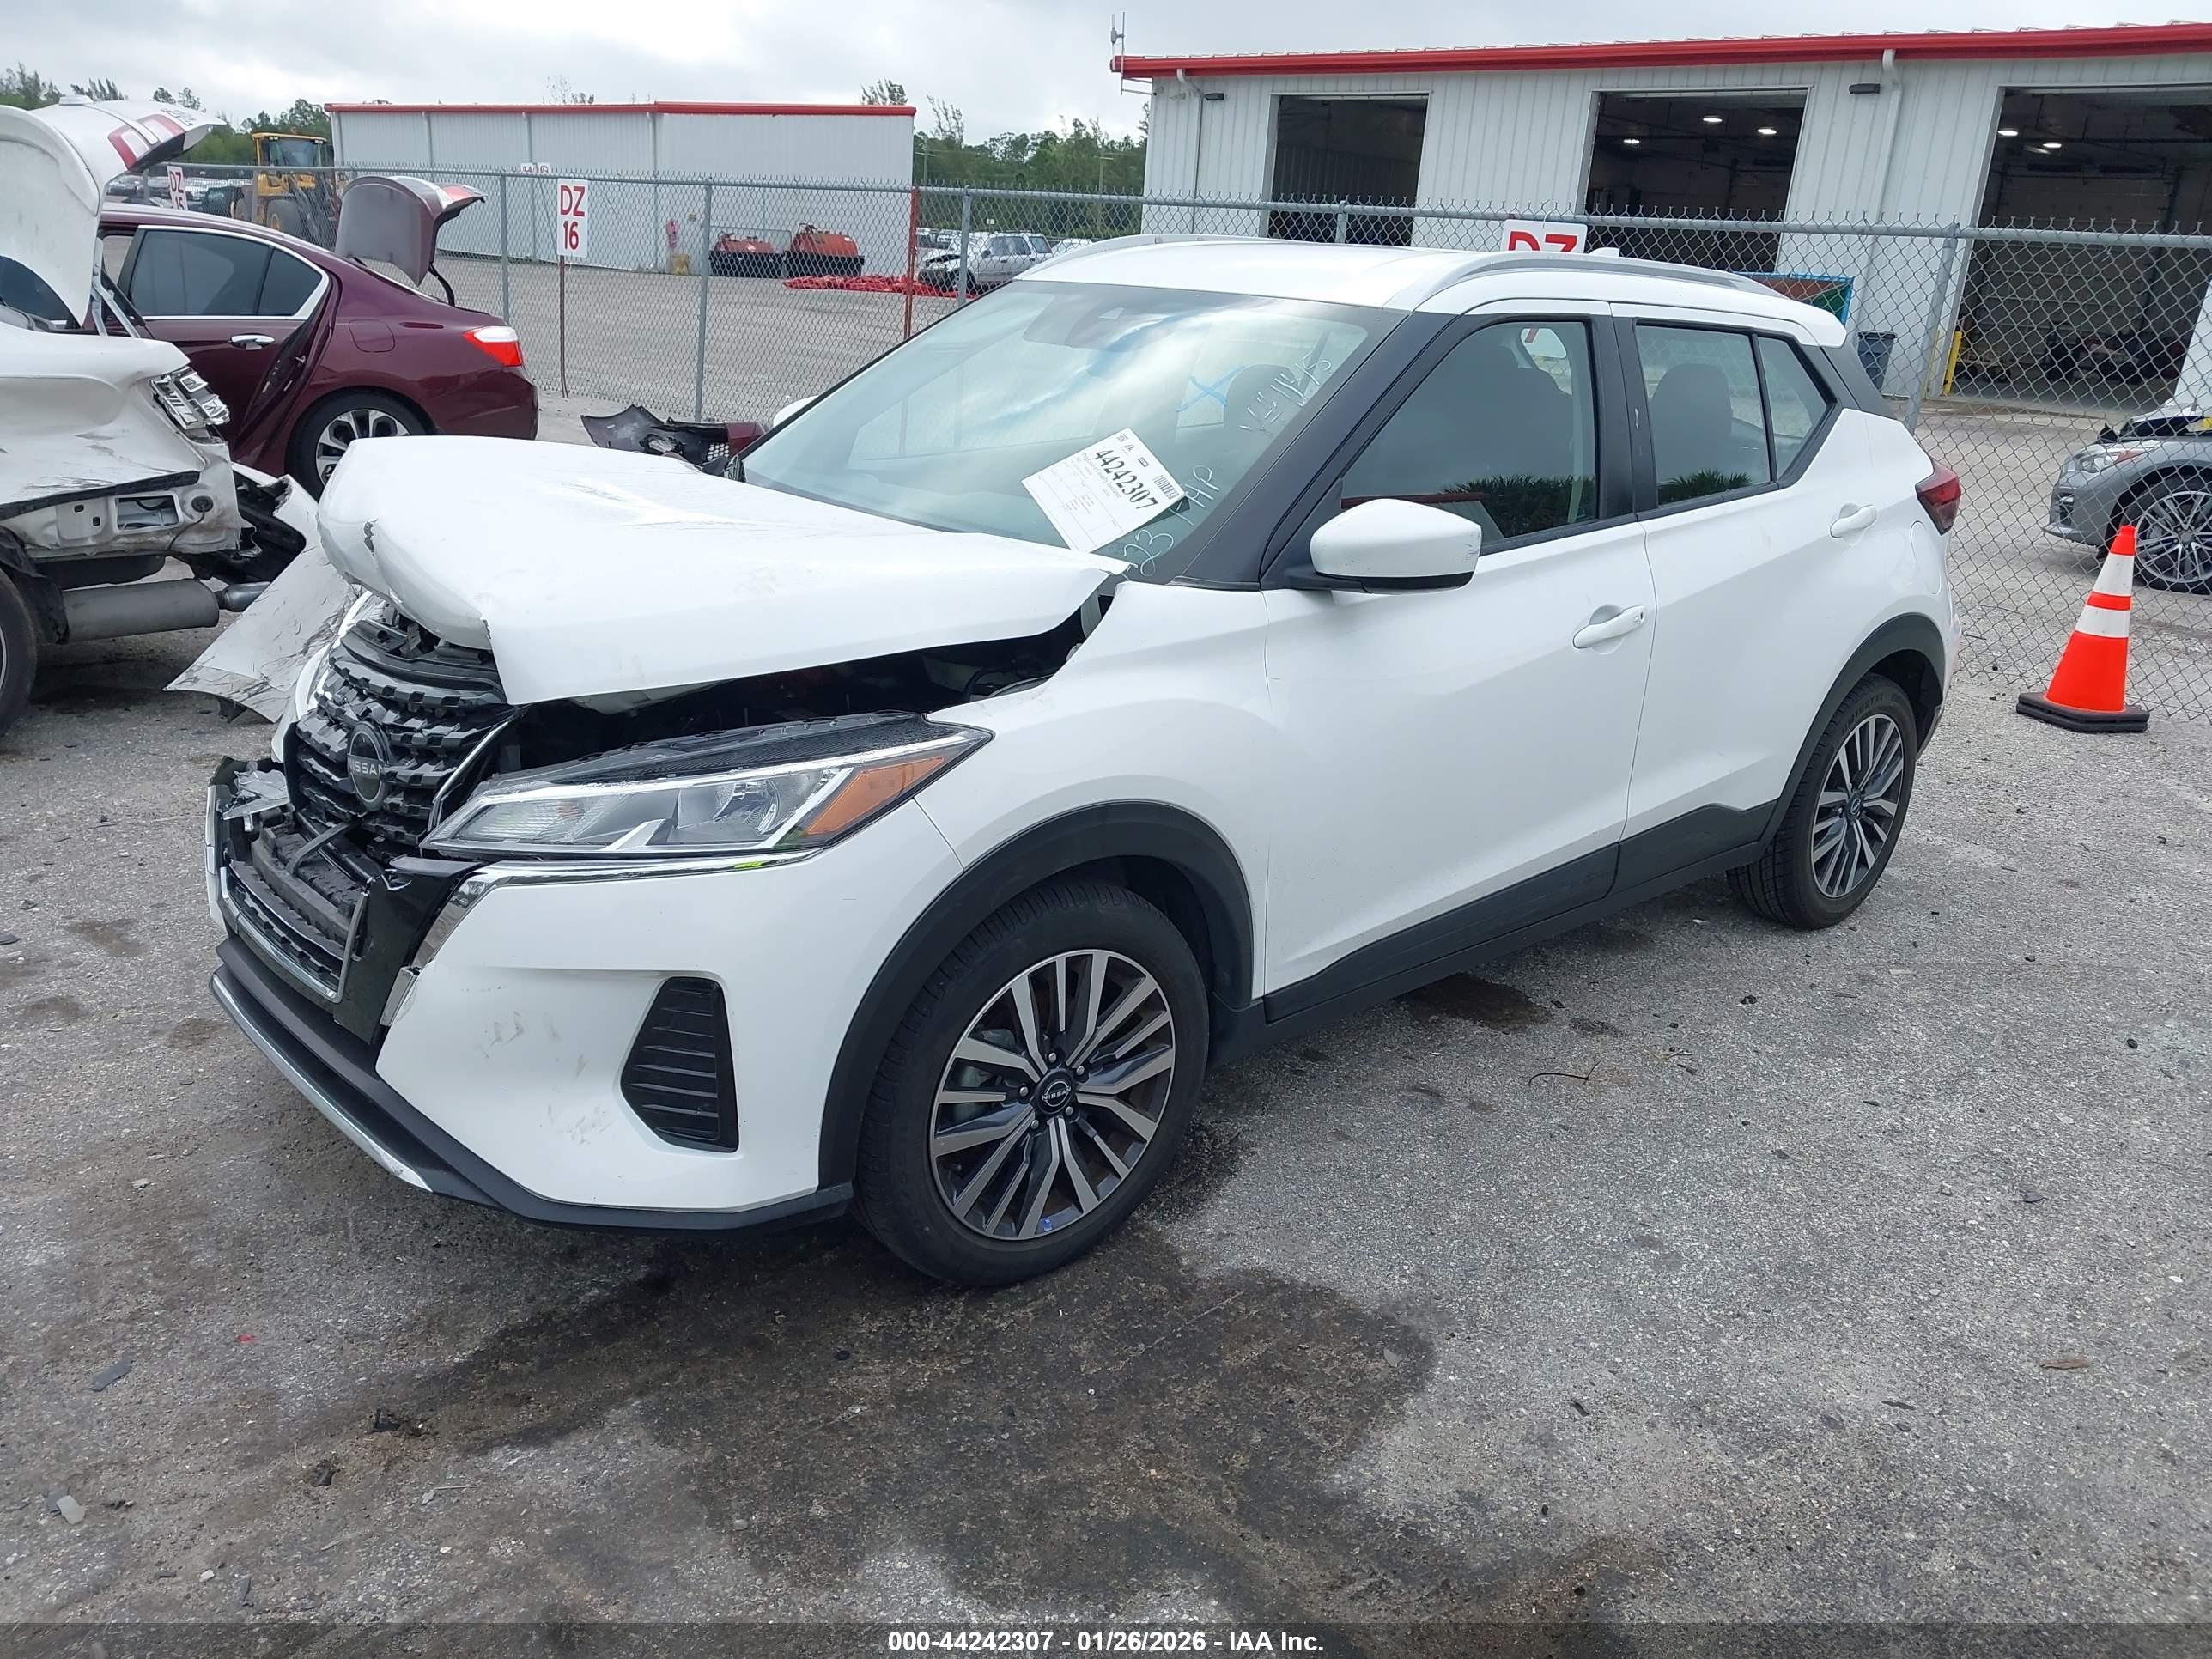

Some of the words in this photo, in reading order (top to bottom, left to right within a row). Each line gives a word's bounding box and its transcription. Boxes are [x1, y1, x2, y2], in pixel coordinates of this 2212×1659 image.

[560, 185, 586, 217] DZ
[562, 220, 580, 251] 16
[1094, 449, 1159, 510] 44242307
[1041, 1085, 1072, 1101] NISSAN
